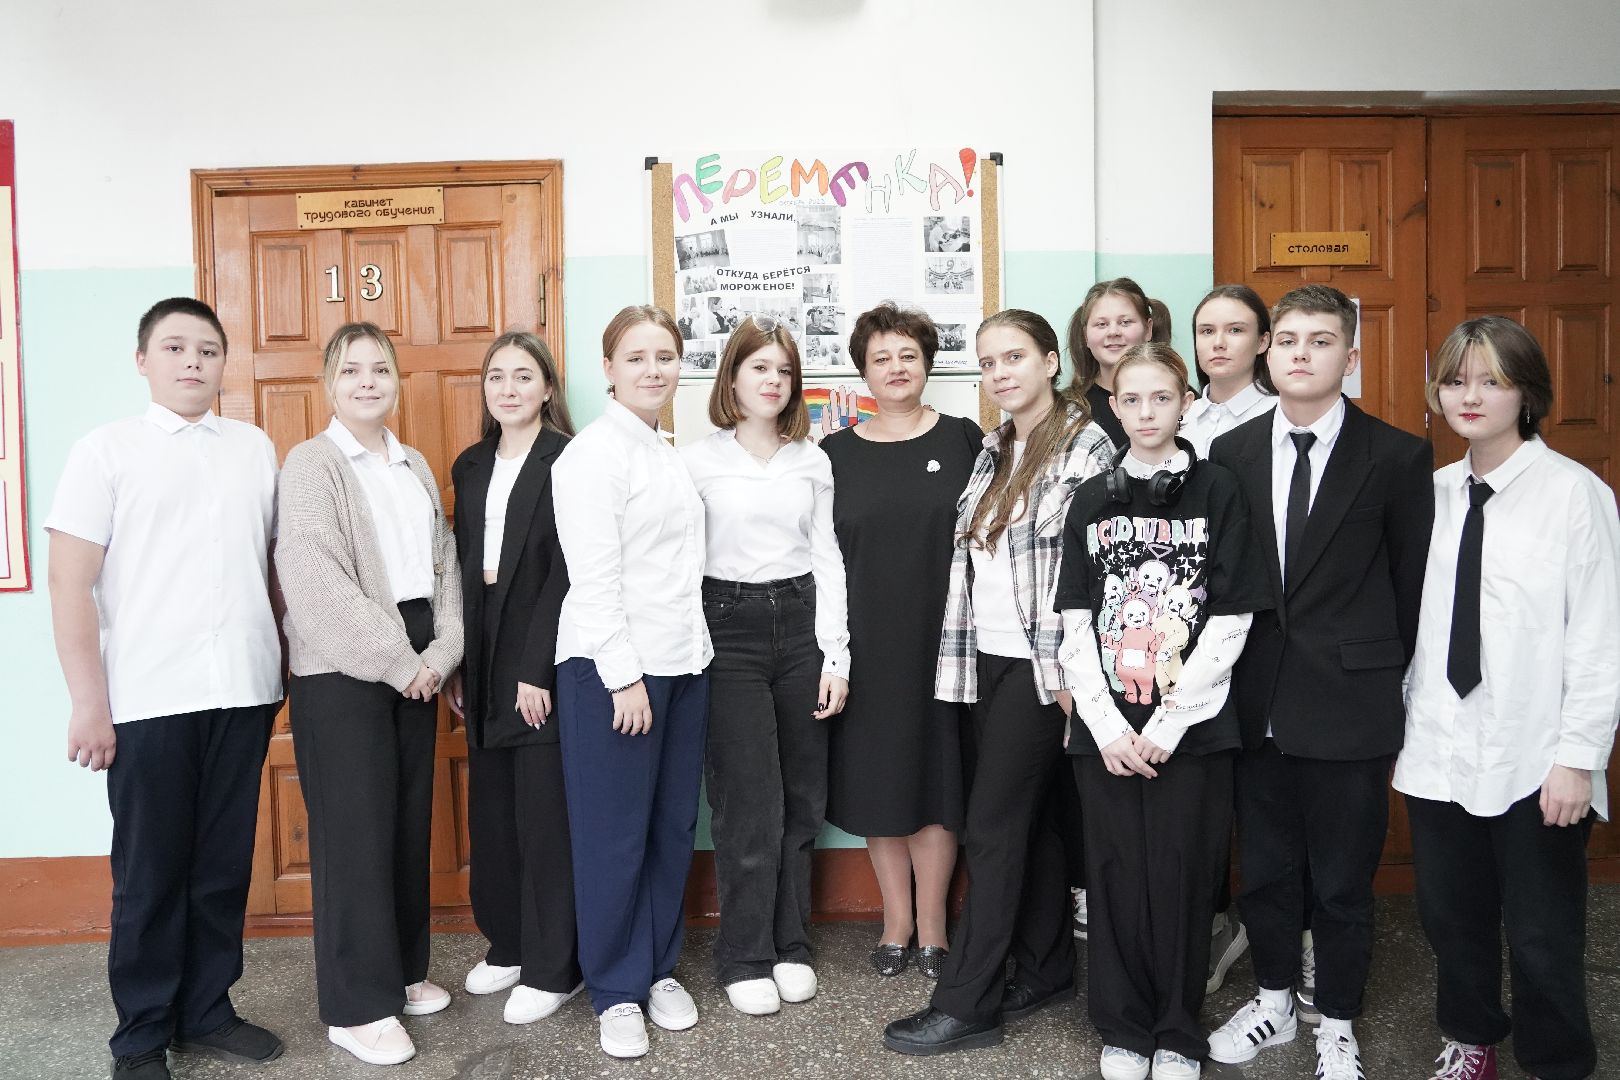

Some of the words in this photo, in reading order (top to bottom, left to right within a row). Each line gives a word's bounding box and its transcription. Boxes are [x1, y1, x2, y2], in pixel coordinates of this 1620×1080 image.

[674, 148, 976, 223] ПЕРЕМЕНКА!
[710, 217, 718, 226] А
[720, 212, 739, 223] МЫ
[325, 263, 384, 302] 13
[716, 268, 759, 281] ОТКУДА
[762, 265, 811, 281] БЕРЁТСЯ
[720, 282, 795, 291] МОРОЖЕНОЕ!
[1086, 515, 1134, 556] ACID
